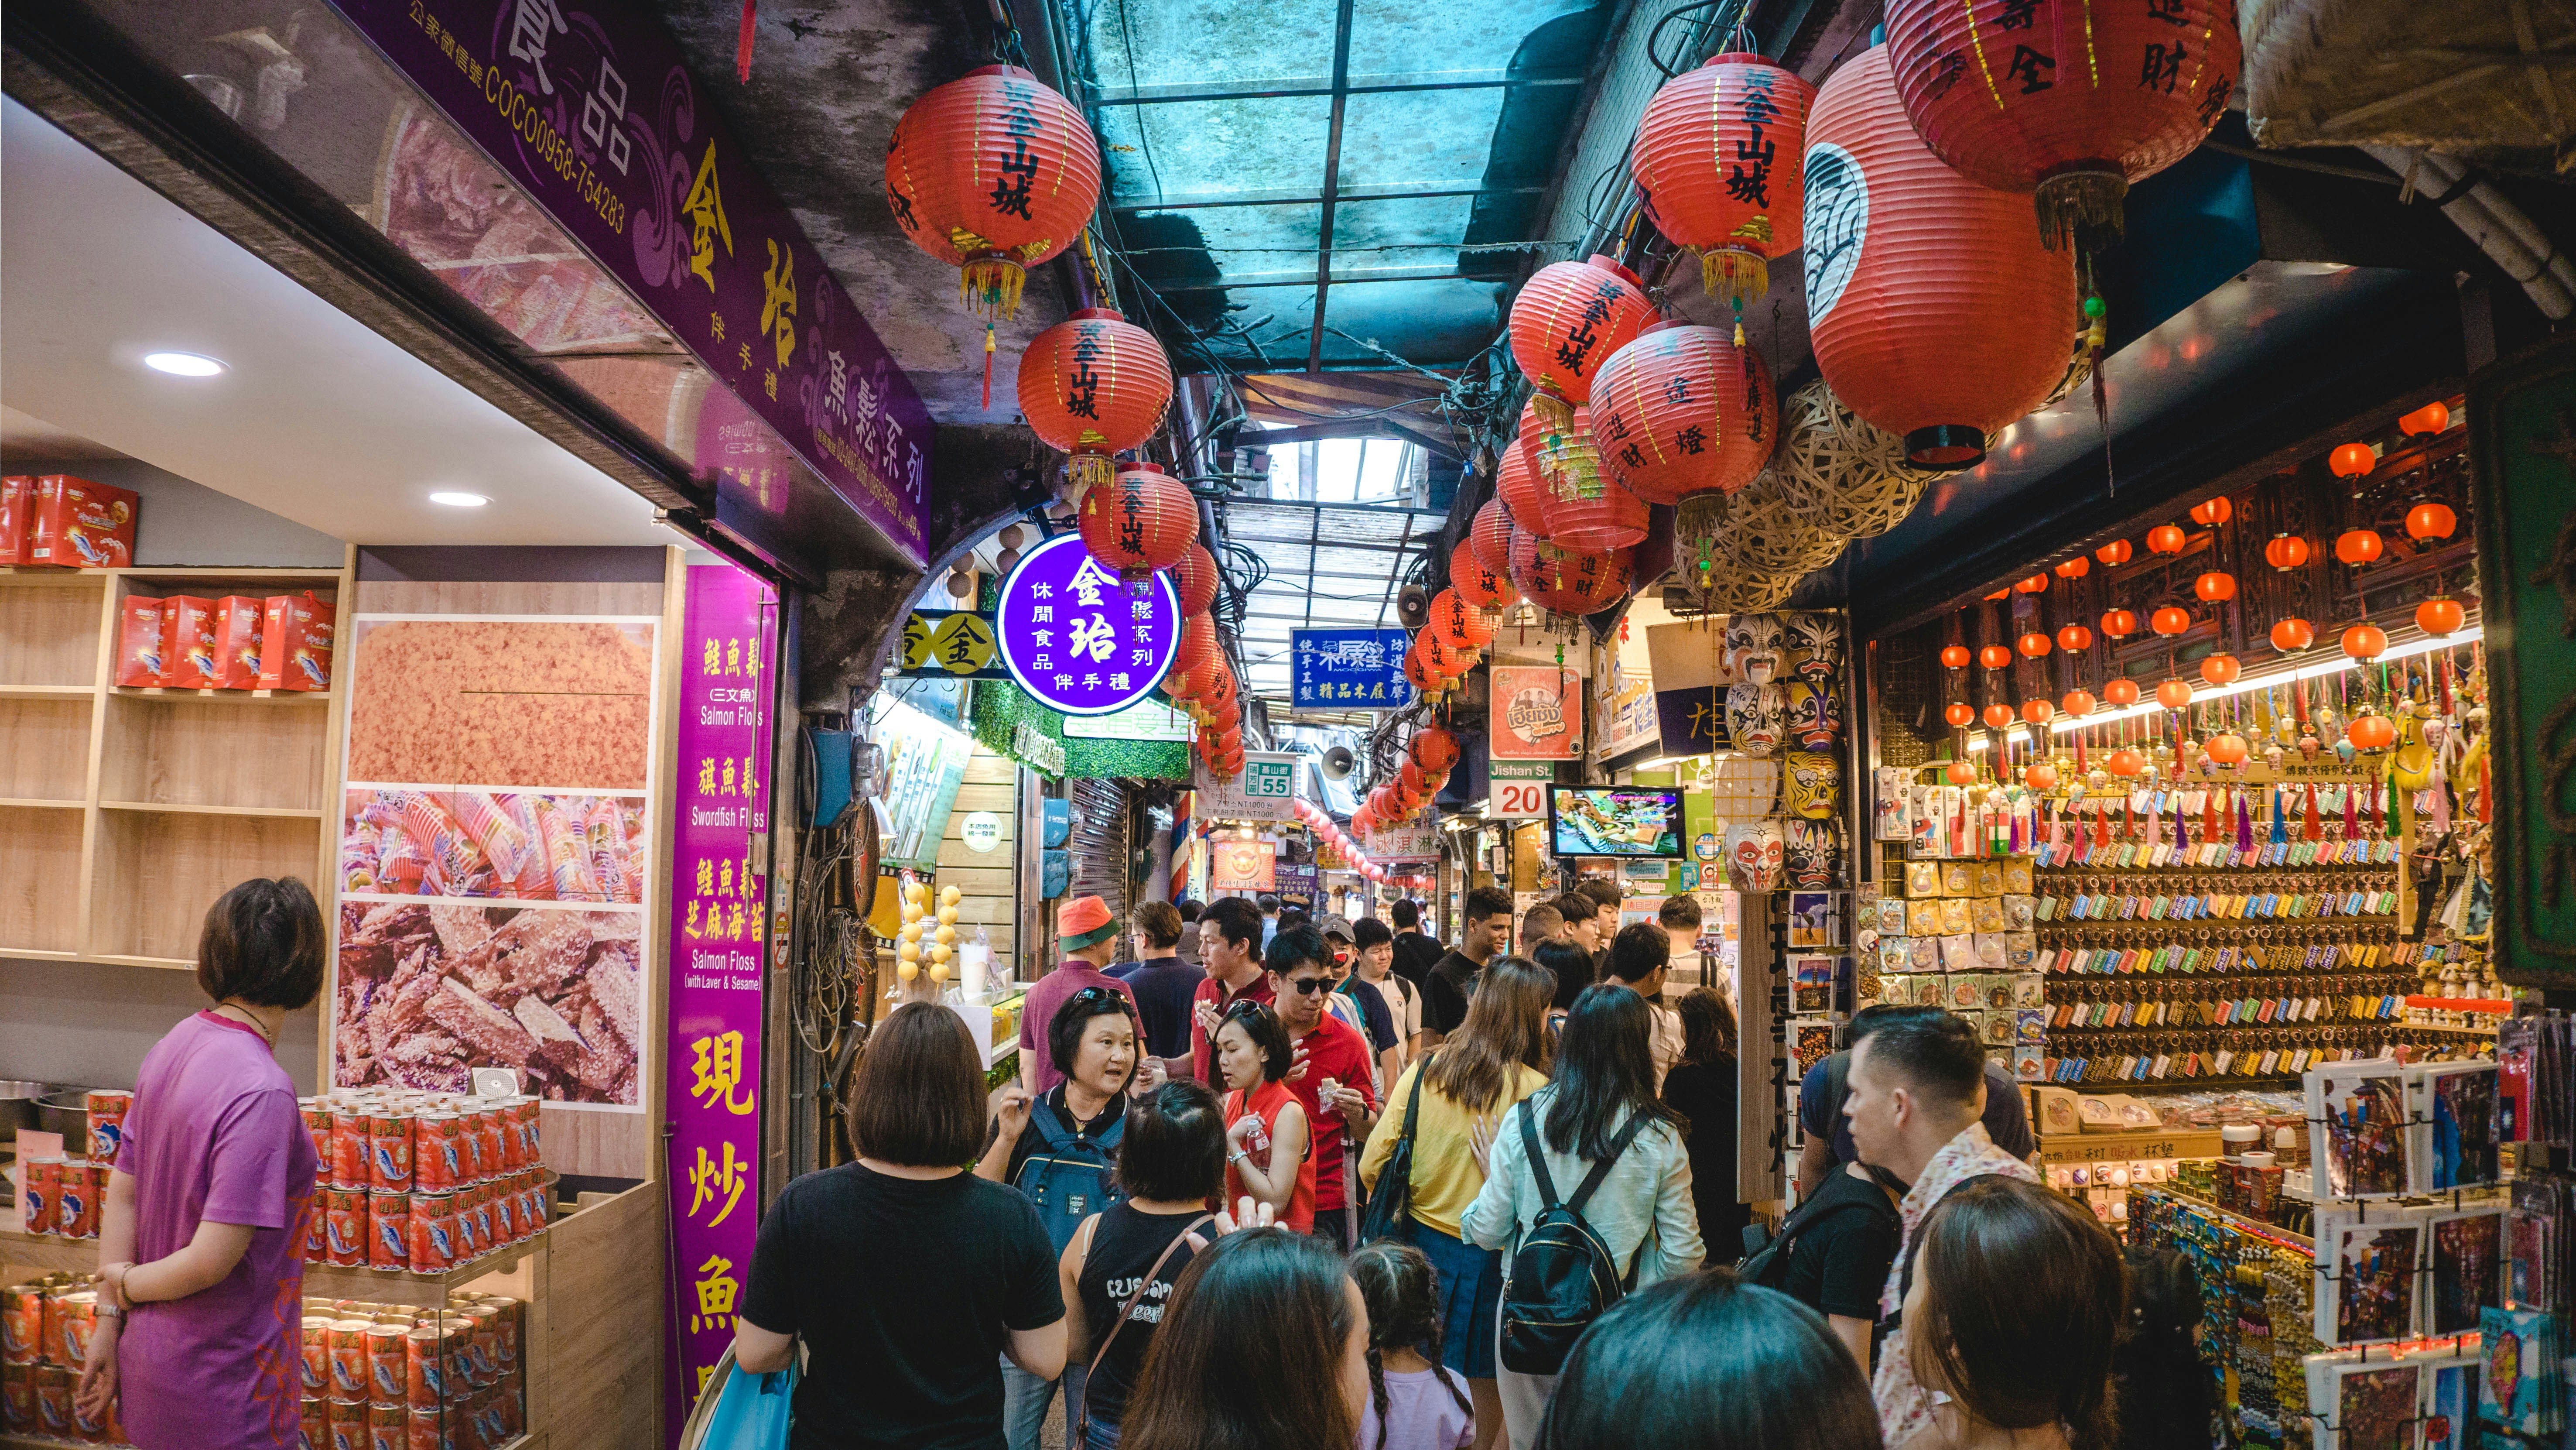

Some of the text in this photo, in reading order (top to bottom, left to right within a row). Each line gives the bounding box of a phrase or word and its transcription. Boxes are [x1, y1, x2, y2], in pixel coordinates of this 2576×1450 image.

[824, 351, 924, 504] 魚鬆系列
[1031, 582, 1054, 670] 休閒食品
[703, 638, 764, 678] 鮭魚鬆
[1054, 672, 1131, 691] 伴手禮
[1319, 682, 1386, 699] 精品木屐
[710, 688, 756, 704] (三文魚)
[701, 705, 763, 726] Salmon Flos
[698, 757, 760, 798] 旗魚鬆
[1262, 766, 1288, 775] 基山街
[1491, 764, 1552, 777] Jishan St.
[1263, 778, 1286, 794] 55
[1502, 786, 1540, 812] 20
[692, 806, 764, 828] Swordfish Flss
[1374, 834, 1433, 854] 冰淇淋
[697, 858, 757, 899] 鮭魚鬆
[2124, 898, 2135, 918] MAR-0307
[2172, 897, 2184, 918] MAR-0310
[2184, 897, 2196, 917] MAR-0311
[685, 900, 765, 943] 芝麻海苔
[692, 950, 755, 971] Salmon Floss
[2306, 947, 2319, 967] APR-0419
[2323, 947, 2335, 967] APR-0420
[685, 973, 762, 991] (with Laver & Sesame)
[2073, 1059, 2085, 1079] JUN-0604
[688, 1030, 754, 1402] 現炒魚
